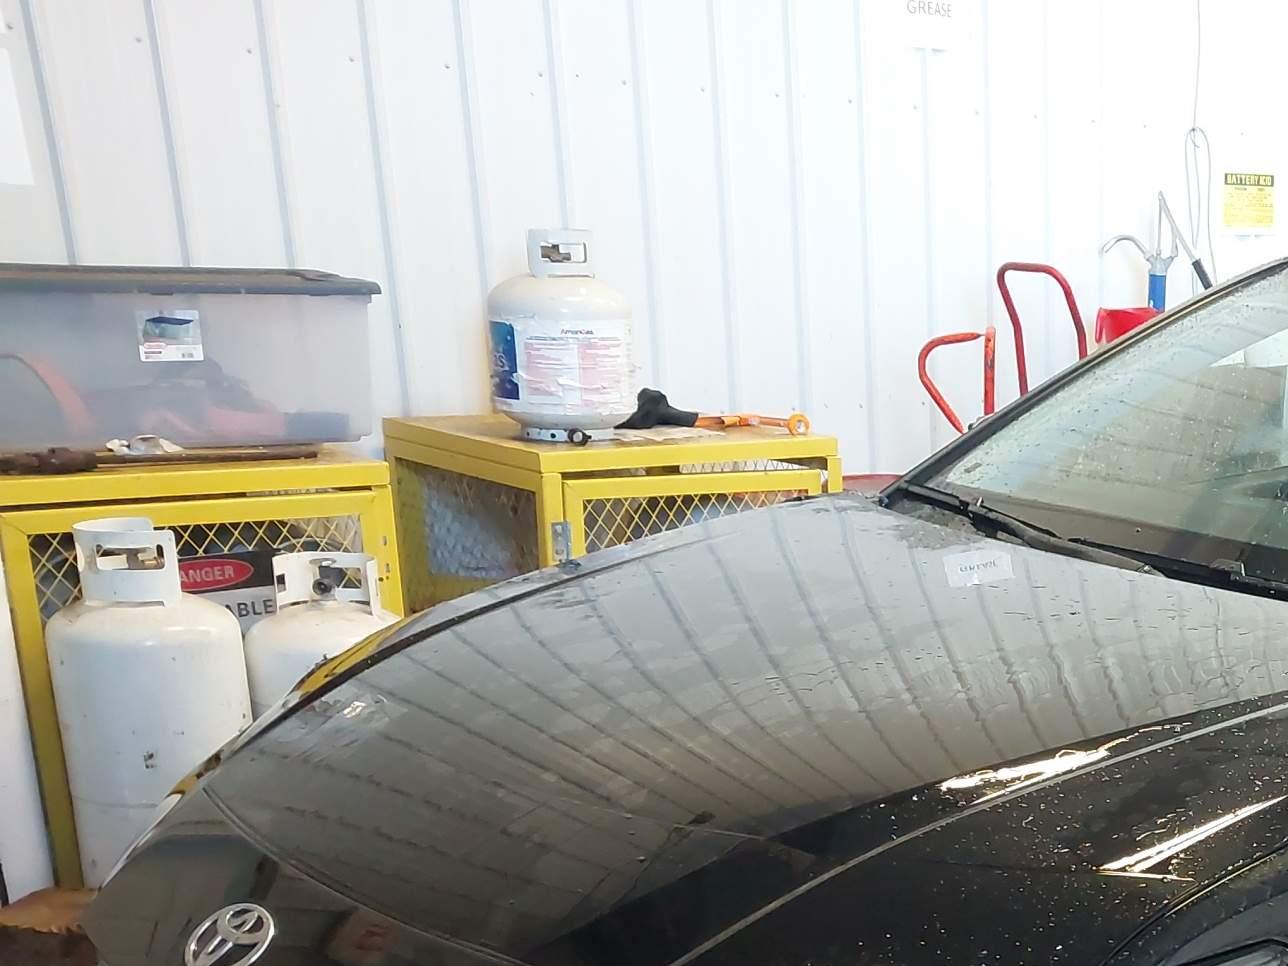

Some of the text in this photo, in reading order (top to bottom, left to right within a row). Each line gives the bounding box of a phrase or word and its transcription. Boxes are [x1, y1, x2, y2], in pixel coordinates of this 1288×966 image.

[906, 0, 952, 18] GREASE
[1227, 174, 1272, 186] BATTERY ACID
[181, 565, 235, 584] ANGER
